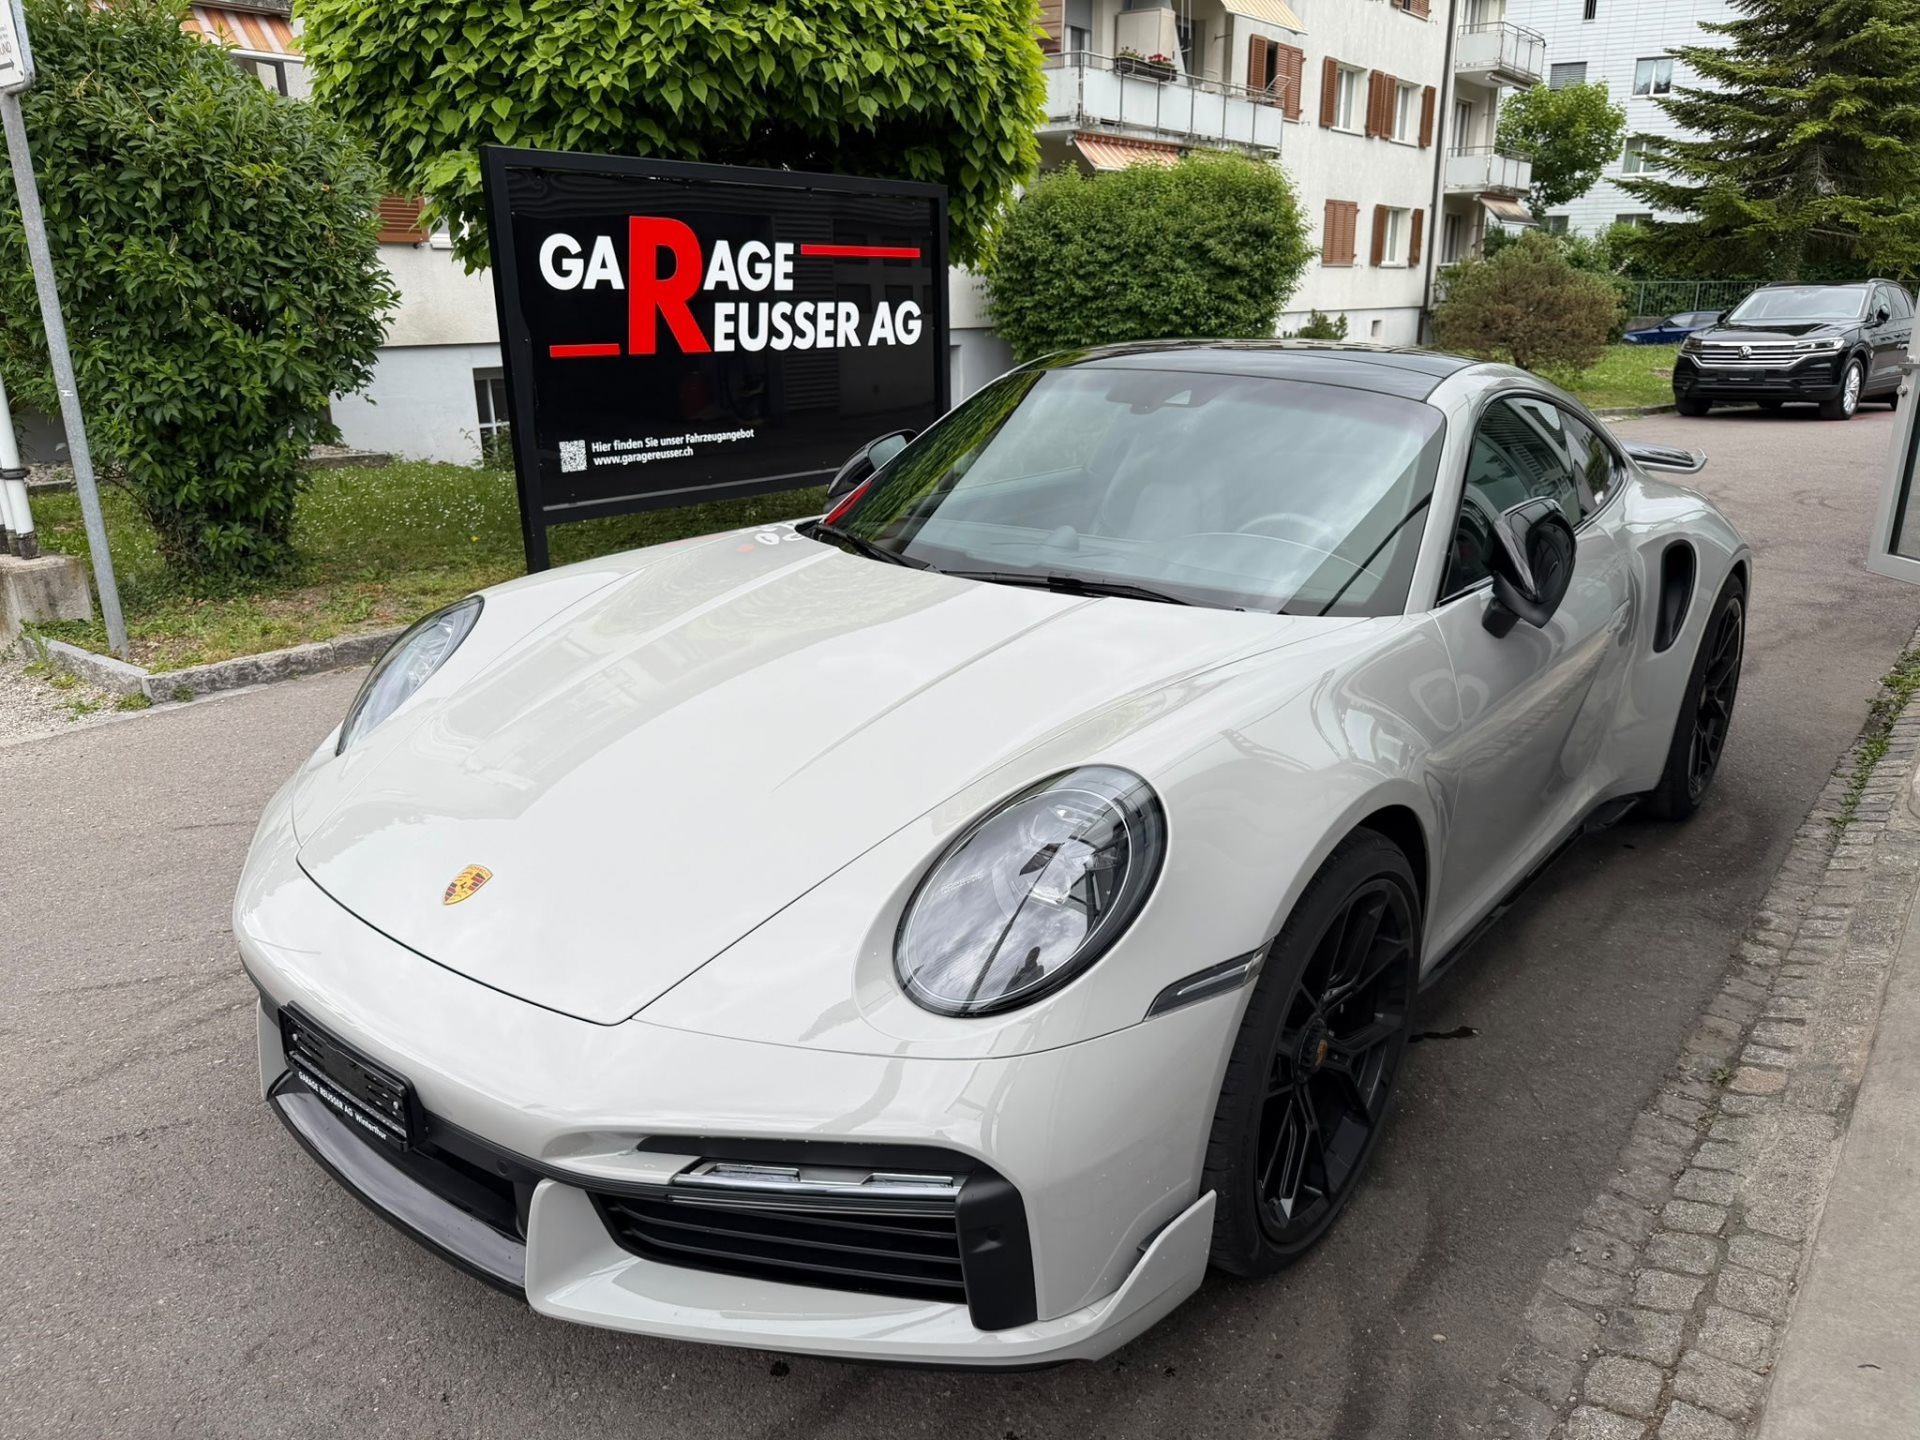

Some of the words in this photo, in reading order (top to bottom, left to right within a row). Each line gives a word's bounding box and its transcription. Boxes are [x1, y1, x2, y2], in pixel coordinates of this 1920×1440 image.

[539, 216, 794, 355] GARAGE
[868, 300, 922, 347] AG
[591, 441, 612, 453] Hier
[612, 438, 644, 451] finden
[644, 436, 659, 448] Sie
[659, 436, 684, 446] unser
[685, 428, 755, 443] Fahrzeugangebot
[592, 445, 694, 466] www.garagereusser.ch
